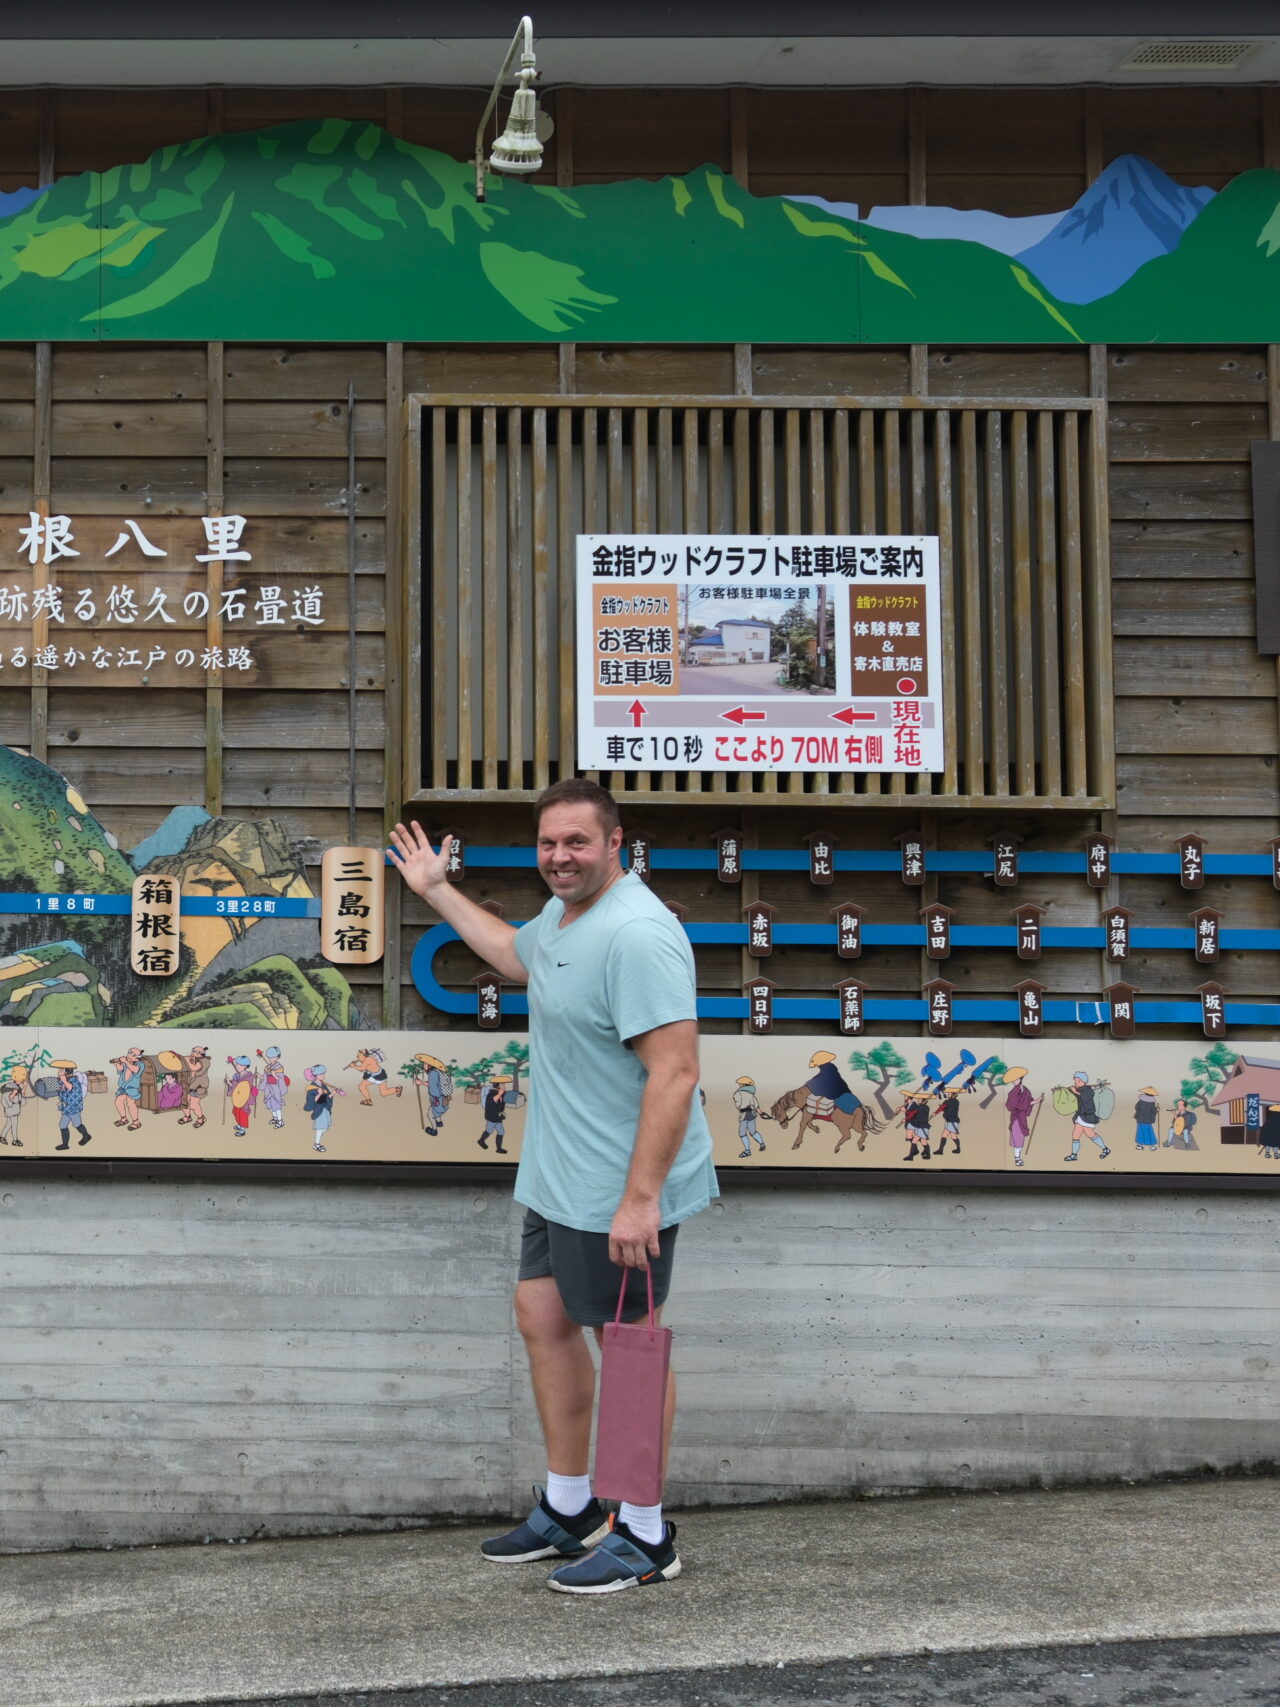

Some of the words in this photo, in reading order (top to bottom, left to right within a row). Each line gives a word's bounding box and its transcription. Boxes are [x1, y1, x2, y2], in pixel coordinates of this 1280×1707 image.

[592, 544, 924, 579] 金指ウッドクラフト駐車場ご案内
[600, 596, 669, 616] 金指ウッドクラフト
[698, 586, 811, 600] お客様駐車場全景
[855, 595, 919, 610] 金指ウッドクラフト
[598, 627, 673, 654] お客様
[853, 620, 921, 638] 体験教室
[881, 640, 896, 653] &
[599, 660, 673, 686] 駐車場
[854, 656, 924, 673] 寄木直売店
[606, 734, 704, 764] 車で10秒
[891, 699, 923, 768] 現在地
[631, 839, 647, 875] 吉原
[721, 838, 738, 875] 蒲原
[813, 842, 831, 875] 由比
[905, 842, 923, 877] 興津
[997, 843, 1016, 878] 江尻
[1089, 844, 1108, 879] 府中
[1182, 845, 1202, 881] 丸子
[215, 898, 277, 914] 3里28町
[332, 861, 373, 953] 三島宿
[136, 878, 176, 974] 箱根宿
[752, 912, 770, 948] 赤坂
[840, 915, 859, 950] 御油
[929, 915, 947, 950] 吉田
[1020, 918, 1038, 951] 二川
[1109, 915, 1127, 958] 白須賀
[1198, 919, 1217, 955] 新居
[480, 984, 499, 1021] 鳴海
[752, 986, 770, 1029] 四日市
[843, 986, 861, 1030] 石薬師
[931, 991, 950, 1027] 庄野
[1022, 991, 1040, 1027] 亀山
[1114, 1002, 1131, 1021] 関
[1204, 994, 1223, 1030] 坂下
[1247, 1096, 1259, 1127] だんご
